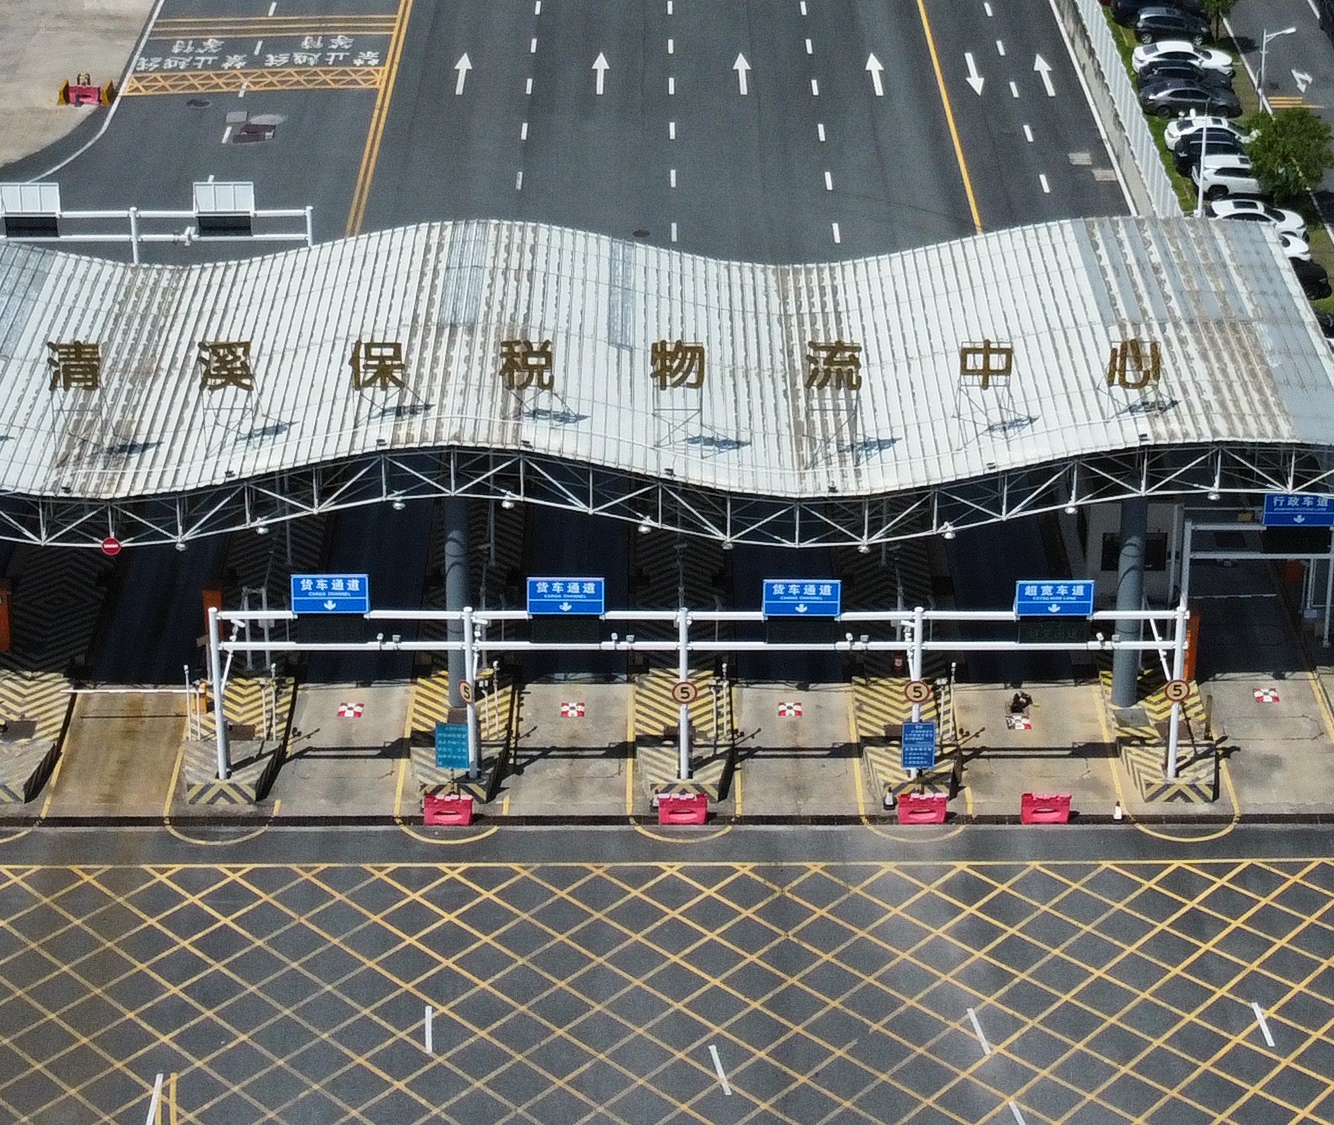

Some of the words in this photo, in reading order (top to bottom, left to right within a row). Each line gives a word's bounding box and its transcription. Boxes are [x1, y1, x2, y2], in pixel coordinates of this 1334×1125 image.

[1272, 496, 1328, 507] 行政车道
[300, 578, 360, 592] 货车通道
[536, 581, 596, 594] 货车通道
[772, 583, 832, 596] 货车通道
[1024, 584, 1085, 597] 超宽车道
[462, 686, 471, 699] 5
[680, 686, 690, 699] 5
[912, 685, 923, 698] 5
[1173, 684, 1182, 697] 5
